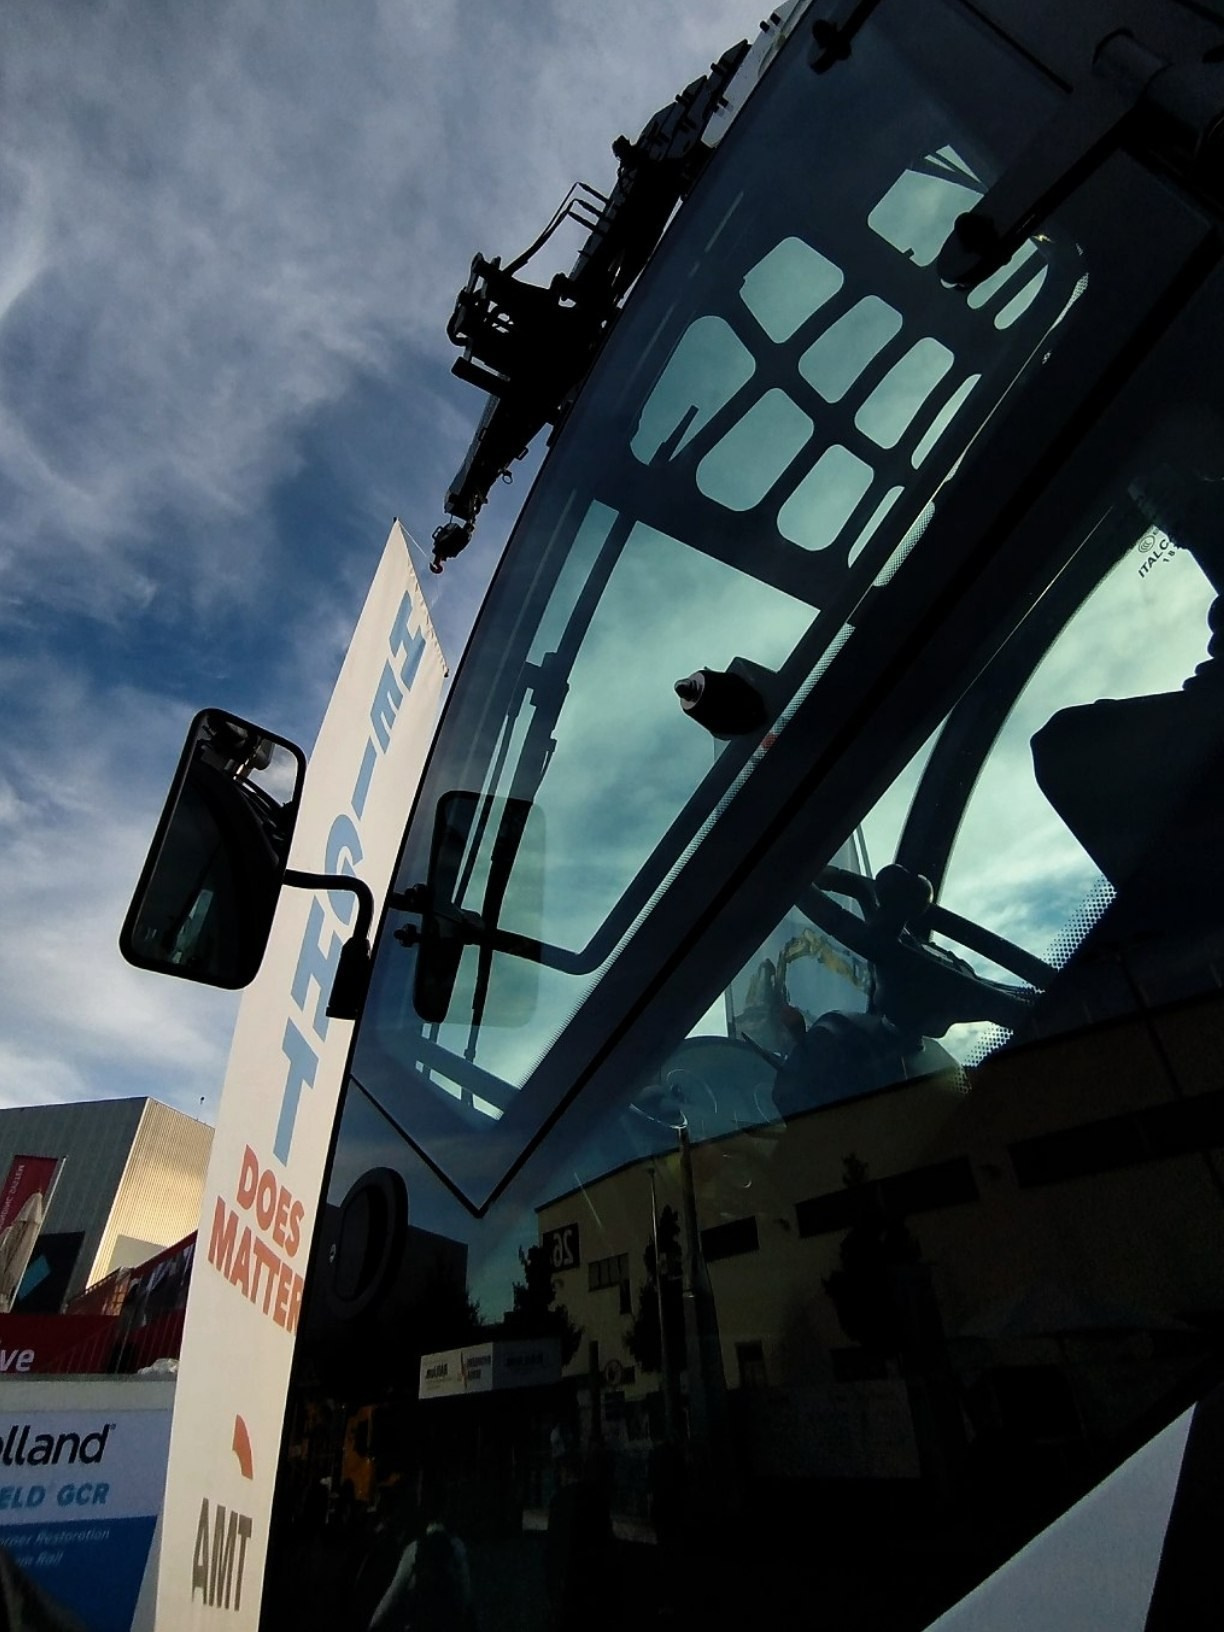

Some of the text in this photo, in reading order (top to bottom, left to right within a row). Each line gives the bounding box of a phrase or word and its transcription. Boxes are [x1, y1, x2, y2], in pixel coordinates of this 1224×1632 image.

[237, 1144, 305, 1258] DOES
[207, 1195, 303, 1334] MATTER
[0, 1348, 36, 1372] ve
[0, 1424, 110, 1466] lland
[57, 1483, 110, 1507] GCR
[191, 1497, 253, 1612] AMT
